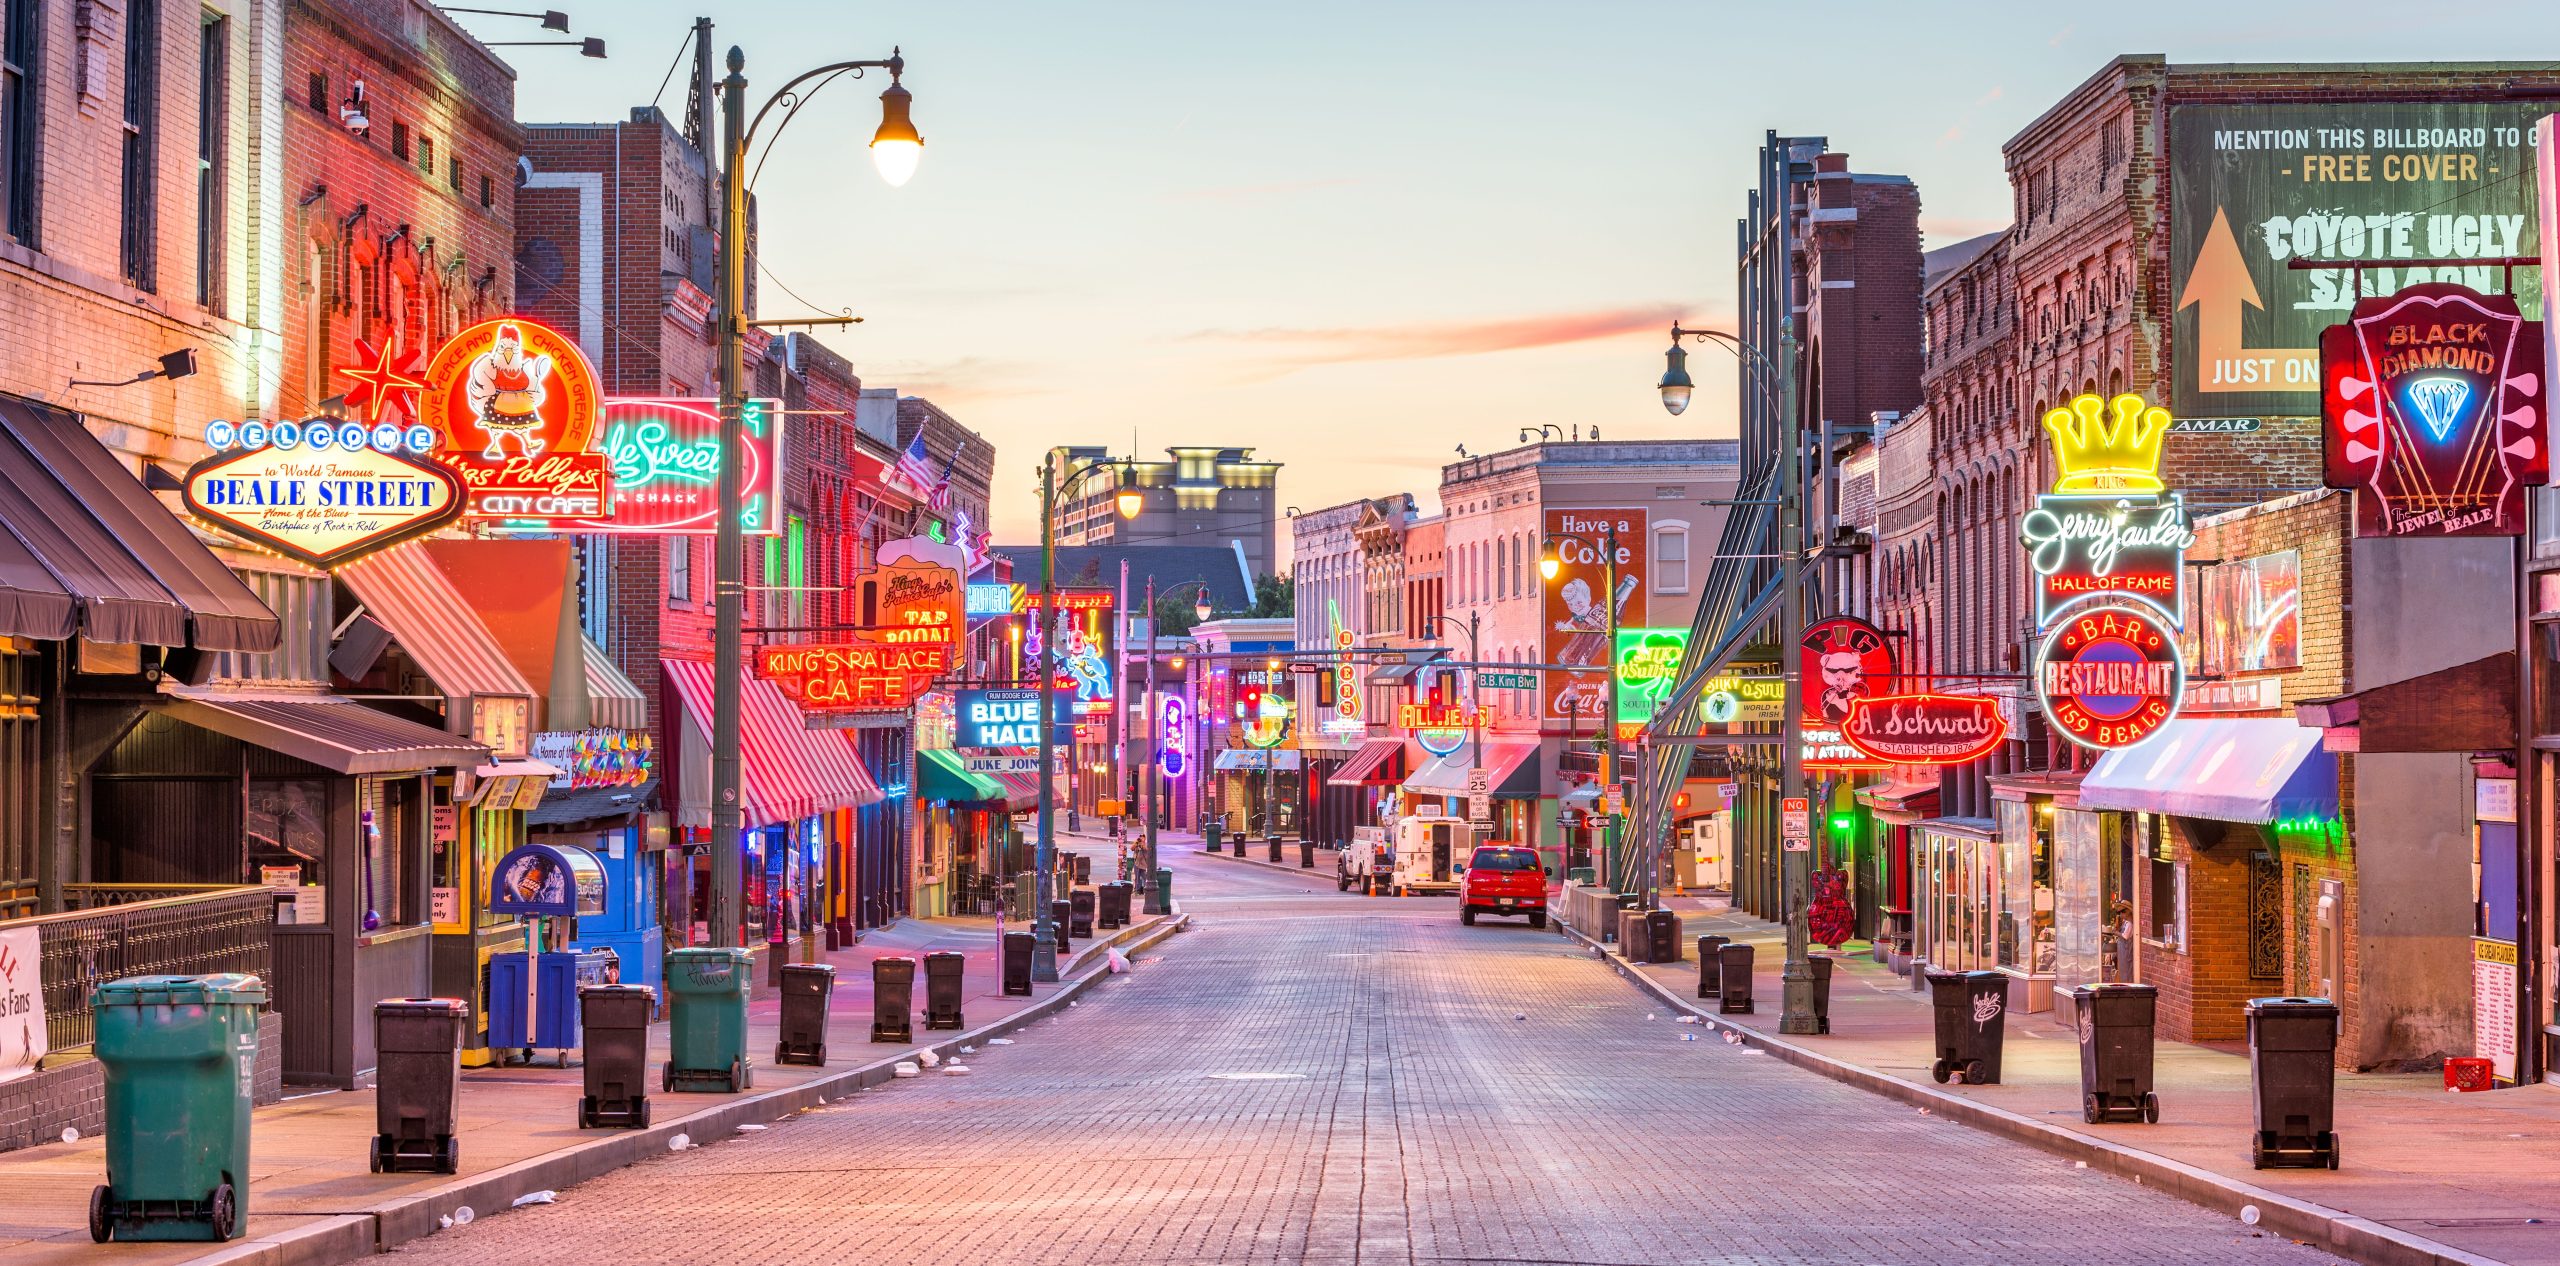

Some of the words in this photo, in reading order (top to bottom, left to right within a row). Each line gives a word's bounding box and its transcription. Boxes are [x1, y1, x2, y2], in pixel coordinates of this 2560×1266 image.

[2214, 129, 2308, 149] MENTION
[2317, 128, 2365, 148] THIS
[2374, 127, 2486, 148] BILLBOARD
[2494, 127, 2520, 147] TO
[2304, 155, 2372, 182] FREE
[2384, 154, 2478, 181] COVER
[2261, 210, 2417, 260] COYOTE
[2427, 214, 2525, 258] UGLY
[2389, 323, 2487, 345] BLACK
[2213, 359, 2276, 384] JUST
[2382, 346, 2495, 380] DIAMOND
[436, 346, 467, 388] PEACE
[467, 331, 493, 352] AND
[533, 334, 579, 382] CHICKEN
[569, 384, 587, 441] GREASE
[2170, 419, 2250, 431] AMAR
[210, 423, 432, 450] WELCOME
[264, 466, 277, 477] to
[280, 463, 323, 477] World
[327, 463, 376, 478] Famous
[2094, 475, 2127, 490] KING
[205, 479, 306, 506] BEALE
[318, 480, 436, 507] STREET
[636, 493, 698, 504] SHACK
[263, 508, 298, 518] Home
[297, 509, 305, 519] of
[306, 508, 322, 518] the
[323, 508, 351, 519] Blues
[482, 496, 532, 514] CITY
[536, 496, 599, 515] CAFE
[2391, 507, 2411, 522] The
[2448, 506, 2458, 518] of
[259, 519, 310, 533] Birthplace
[312, 520, 322, 533] of
[322, 519, 346, 531] Rock
[355, 519, 383, 531] Roll
[1561, 515, 1610, 533] Have
[1617, 520, 1630, 533] a
[2396, 509, 2444, 535] JEWEL
[2442, 508, 2494, 534] BEALE
[2022, 508, 2114, 576] Jerry
[2092, 499, 2198, 577] Lawler
[2050, 577, 2092, 591] HALL
[2098, 576, 2121, 590] OF
[2126, 576, 2173, 591] FAME
[883, 591, 921, 608] Palace
[904, 610, 948, 625] TAP
[2081, 614, 2142, 644] BAR
[1801, 625, 1881, 655] PIG
[807, 677, 903, 701] CAFE
[1479, 675, 1498, 687] B.B.
[1498, 675, 1516, 688] King
[1517, 674, 1537, 688] Blvd.
[1706, 677, 1740, 693] SILKY
[2045, 661, 2175, 698] RESTAURANT
[989, 692, 1001, 700] RUM
[1001, 692, 1021, 700] BOOGIE
[1021, 691, 1039, 699] CAFE'S
[971, 702, 1056, 722] BLUE
[1851, 704, 1882, 735] A.
[1885, 702, 1996, 736] Schwab
[2056, 702, 2090, 734] 159
[2098, 701, 2168, 745] BEALE
[540, 745, 558, 759] Home
[558, 745, 565, 761] of
[1878, 742, 1951, 755] ESTABLISHED
[1953, 743, 1974, 754] 1876
[970, 759, 1002, 771] JUKE
[1009, 758, 1041, 770] JOIN
[1470, 781, 1487, 791] 25
[1787, 801, 1803, 810] NO
[9, 988, 30, 1016] Fans
